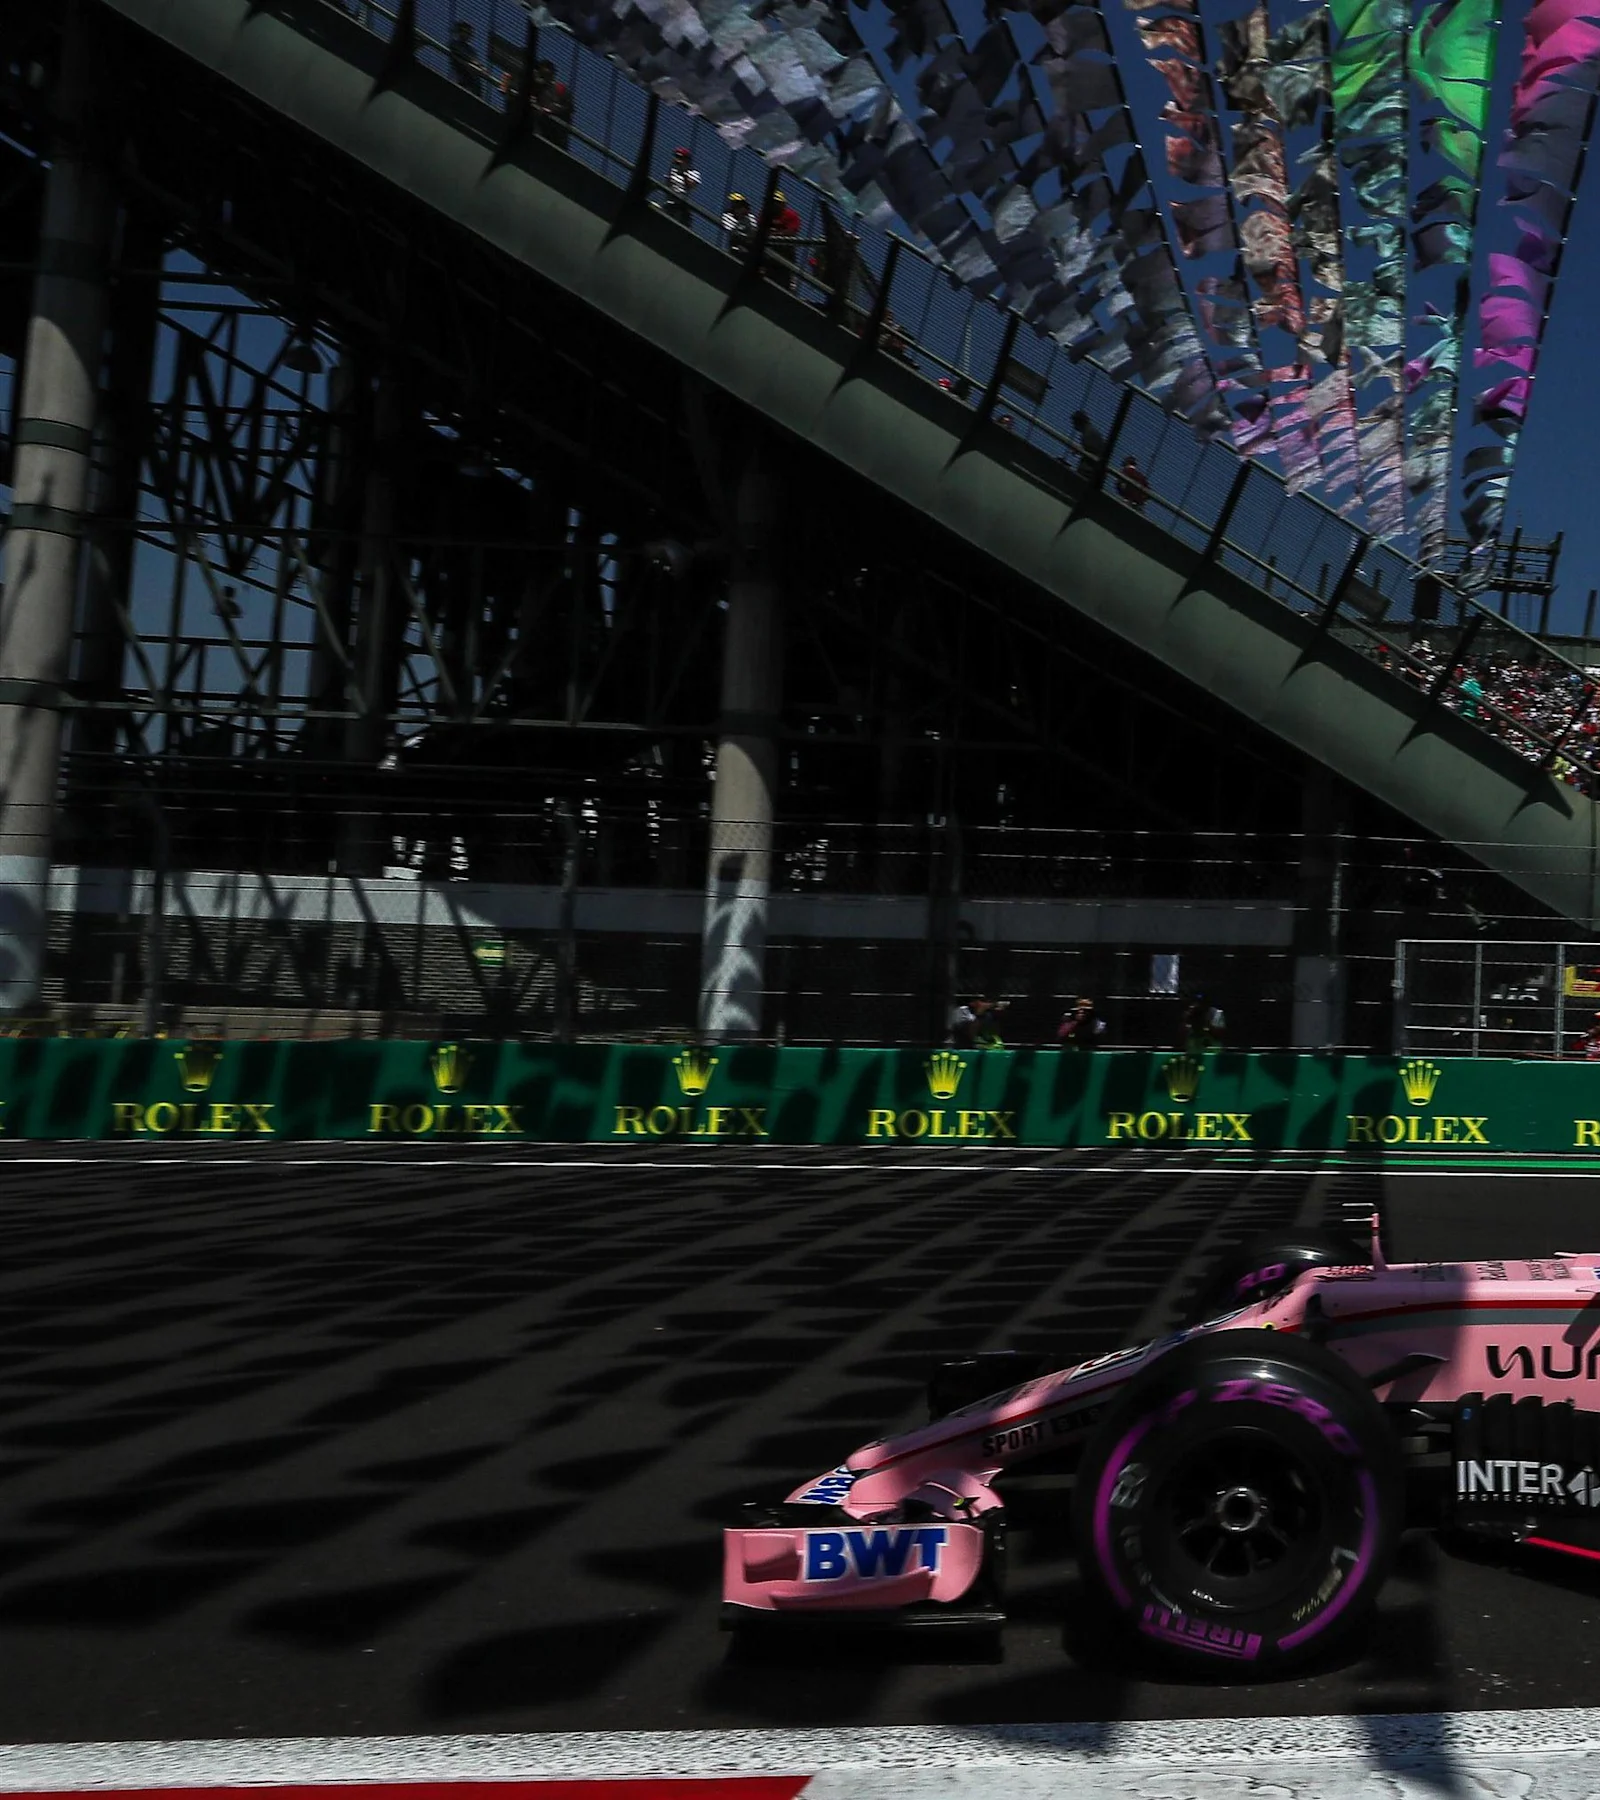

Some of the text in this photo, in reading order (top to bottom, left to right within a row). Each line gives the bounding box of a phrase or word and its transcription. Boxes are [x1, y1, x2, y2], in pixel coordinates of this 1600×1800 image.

[112, 1102, 275, 1133] ROLEX
[367, 1104, 525, 1134] ROLEX
[613, 1105, 769, 1136] ROLEX
[866, 1109, 1016, 1138] ROLEX
[1106, 1112, 1253, 1142] ROLEX
[1347, 1115, 1489, 1145] ROLEX
[982, 1422, 1045, 1458] SPORT
[1457, 1460, 1566, 1497] INTER
[804, 1527, 947, 1582] BWT
